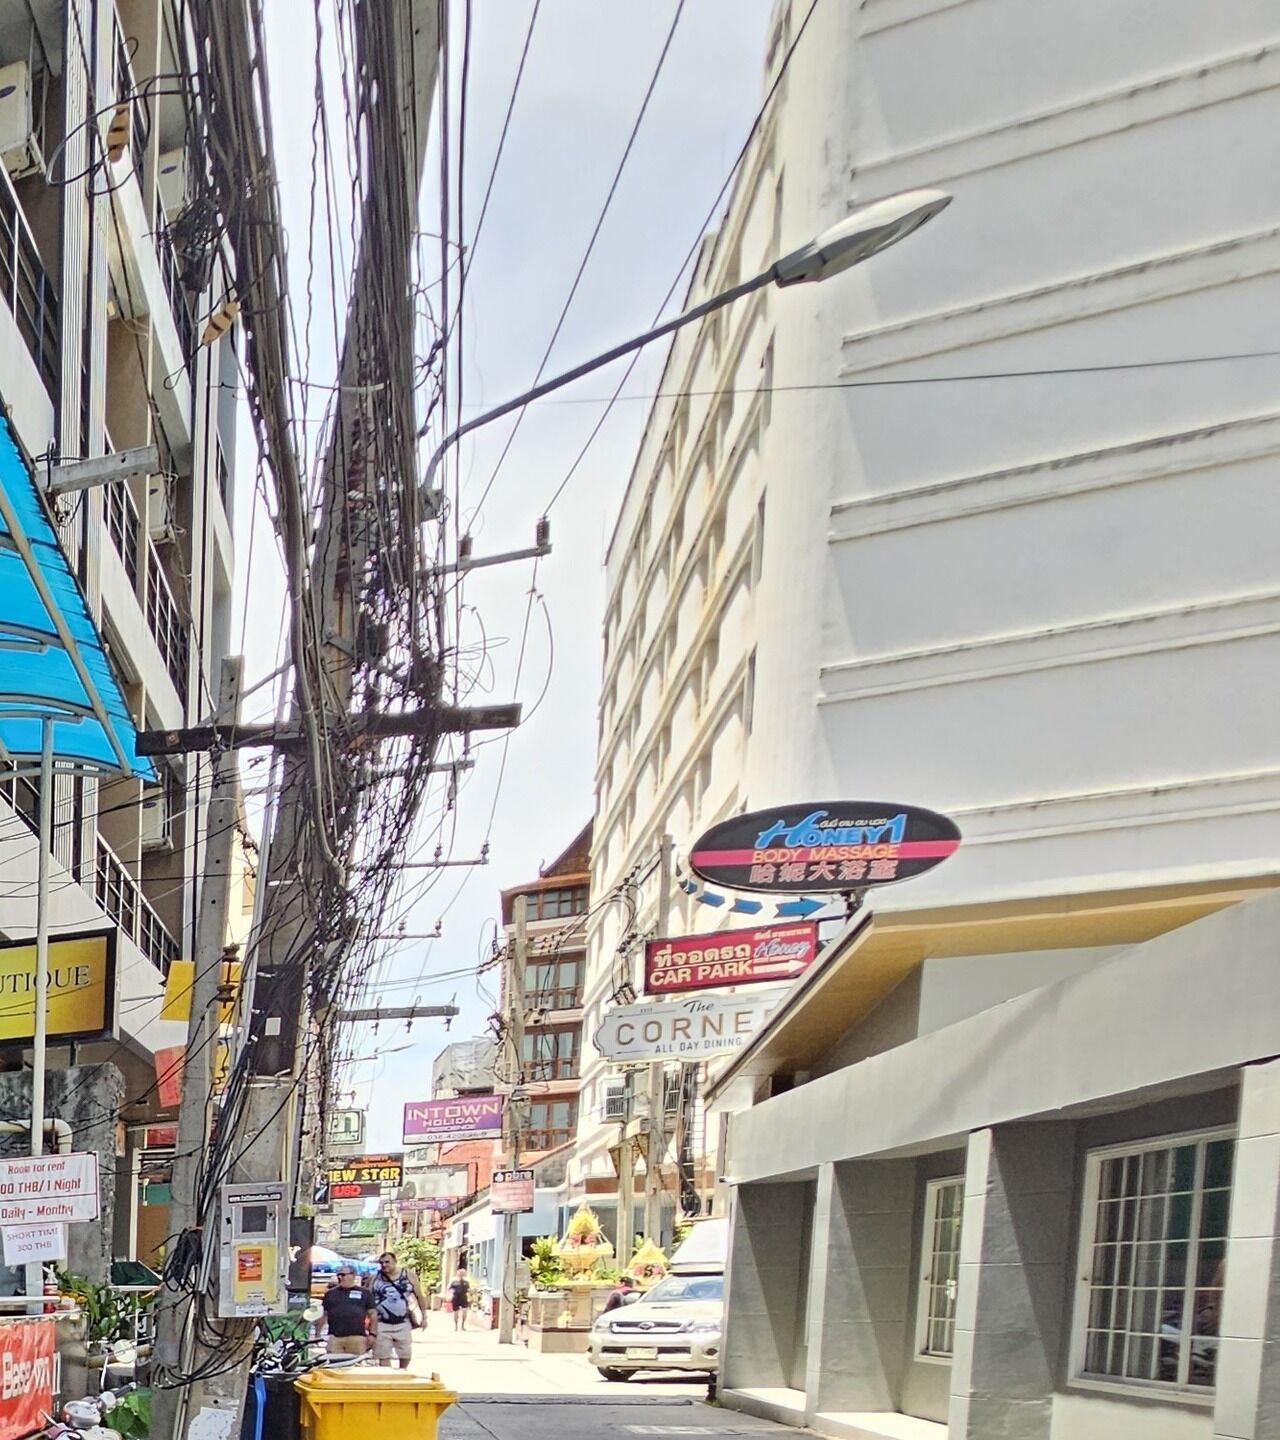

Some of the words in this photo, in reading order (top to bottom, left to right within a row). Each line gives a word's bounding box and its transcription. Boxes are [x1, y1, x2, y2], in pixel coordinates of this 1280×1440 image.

[752, 849, 801, 863] BODY
[810, 845, 900, 861] MASSAGE
[653, 943, 751, 969] ที่จอดรถ
[649, 969, 691, 986] CAR
[697, 961, 754, 981] PARK
[683, 1000, 715, 1013] The
[616, 1010, 764, 1046] CORNE
[655, 1043, 674, 1054] ALL
[680, 1041, 699, 1052] DAY
[704, 1037, 743, 1049] DINING
[408, 1103, 499, 1121] INTOWN
[423, 1116, 482, 1128] HOLIDAY
[8, 1165, 31, 1175] Room
[33, 1163, 45, 1173] for
[47, 1161, 65, 1172] rent
[361, 1167, 401, 1180] STAR
[54, 1177, 81, 1193] Night
[1, 1207, 26, 1220] Daily
[6, 1230, 36, 1241] SHORT
